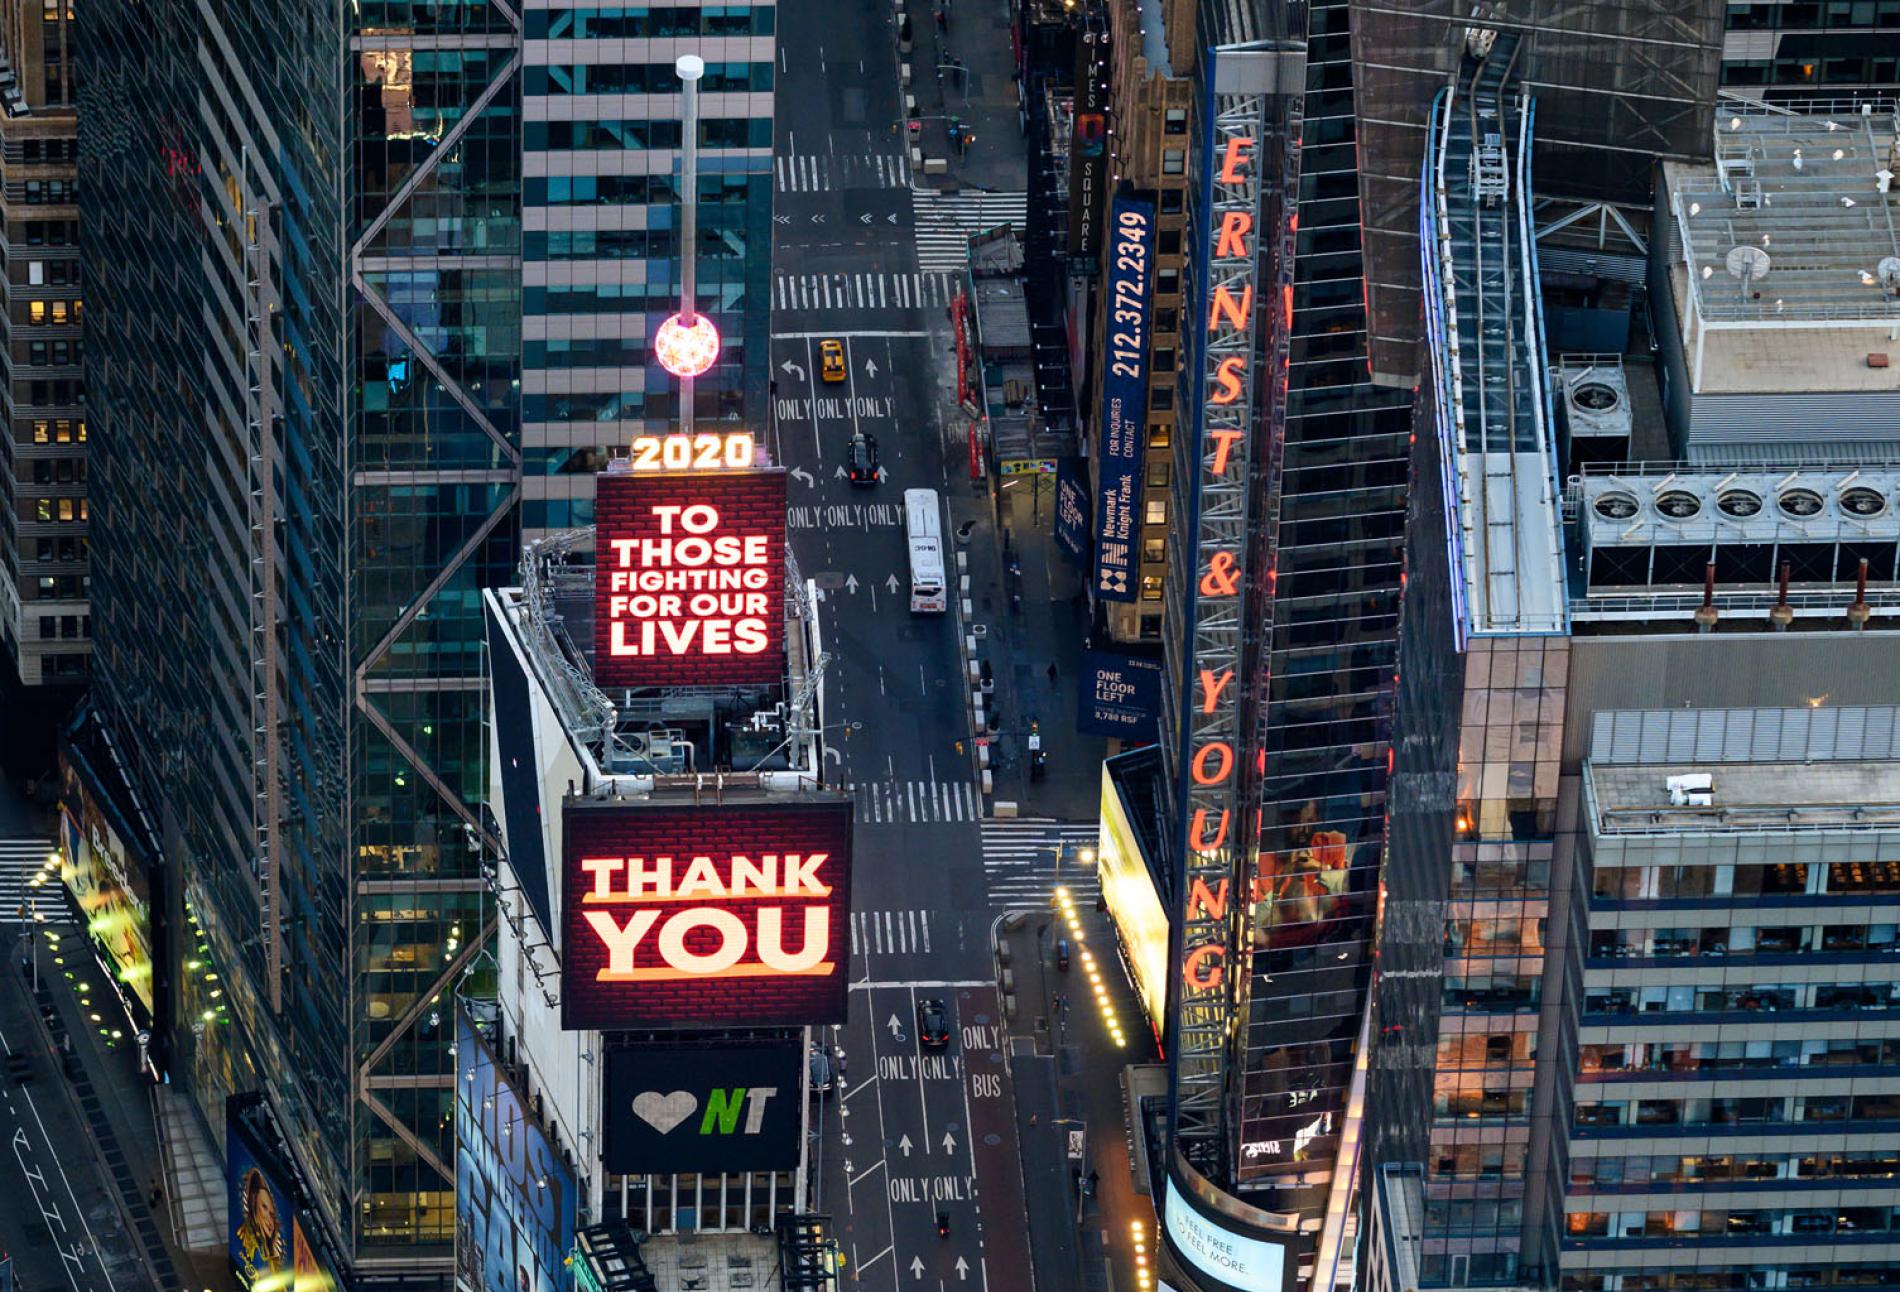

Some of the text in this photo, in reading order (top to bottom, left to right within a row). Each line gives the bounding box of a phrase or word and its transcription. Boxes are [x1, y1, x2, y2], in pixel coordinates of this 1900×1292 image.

[1087, 32, 1099, 108] TIMES
[1081, 162, 1093, 252] SQUARE
[1111, 211, 1147, 379] 212.372.2349
[778, 398, 813, 421] ONLY
[817, 397, 852, 420] ONLY
[857, 396, 893, 418] ONLY
[1123, 419, 1136, 458] CONTACT
[632, 433, 754, 470] 2020
[652, 504, 719, 535] TO
[787, 505, 822, 528] ONLY
[827, 504, 862, 527] ONLY
[868, 503, 903, 526] ONLY
[1103, 488, 1117, 538] Newmark
[1116, 474, 1133, 540] Knight Frank
[610, 536, 769, 568] THOSE
[1183, 137, 1254, 990] ERNST & YOUNG
[610, 568, 769, 592] FIGHTING
[610, 592, 769, 618] FOR OUR
[610, 617, 769, 656] LIVES
[1096, 669, 1122, 683] ONE
[1096, 680, 1136, 695] FLOOR
[1095, 690, 1125, 703] LEFT
[581, 854, 829, 898] THANK
[582, 905, 830, 975] YOU
[962, 1025, 999, 1050] ONLY
[879, 1055, 919, 1080] ONLY
[922, 1055, 960, 1080] ONLY
[972, 1073, 1001, 1098] BUS
[700, 1087, 778, 1136] NT
[890, 1177, 929, 1202] ONLY
[933, 1175, 973, 1200] ONLY
[1187, 1233, 1206, 1255] FEEL
[1209, 1250, 1249, 1275] MORE.
[1206, 1234, 1234, 1256] FREE
